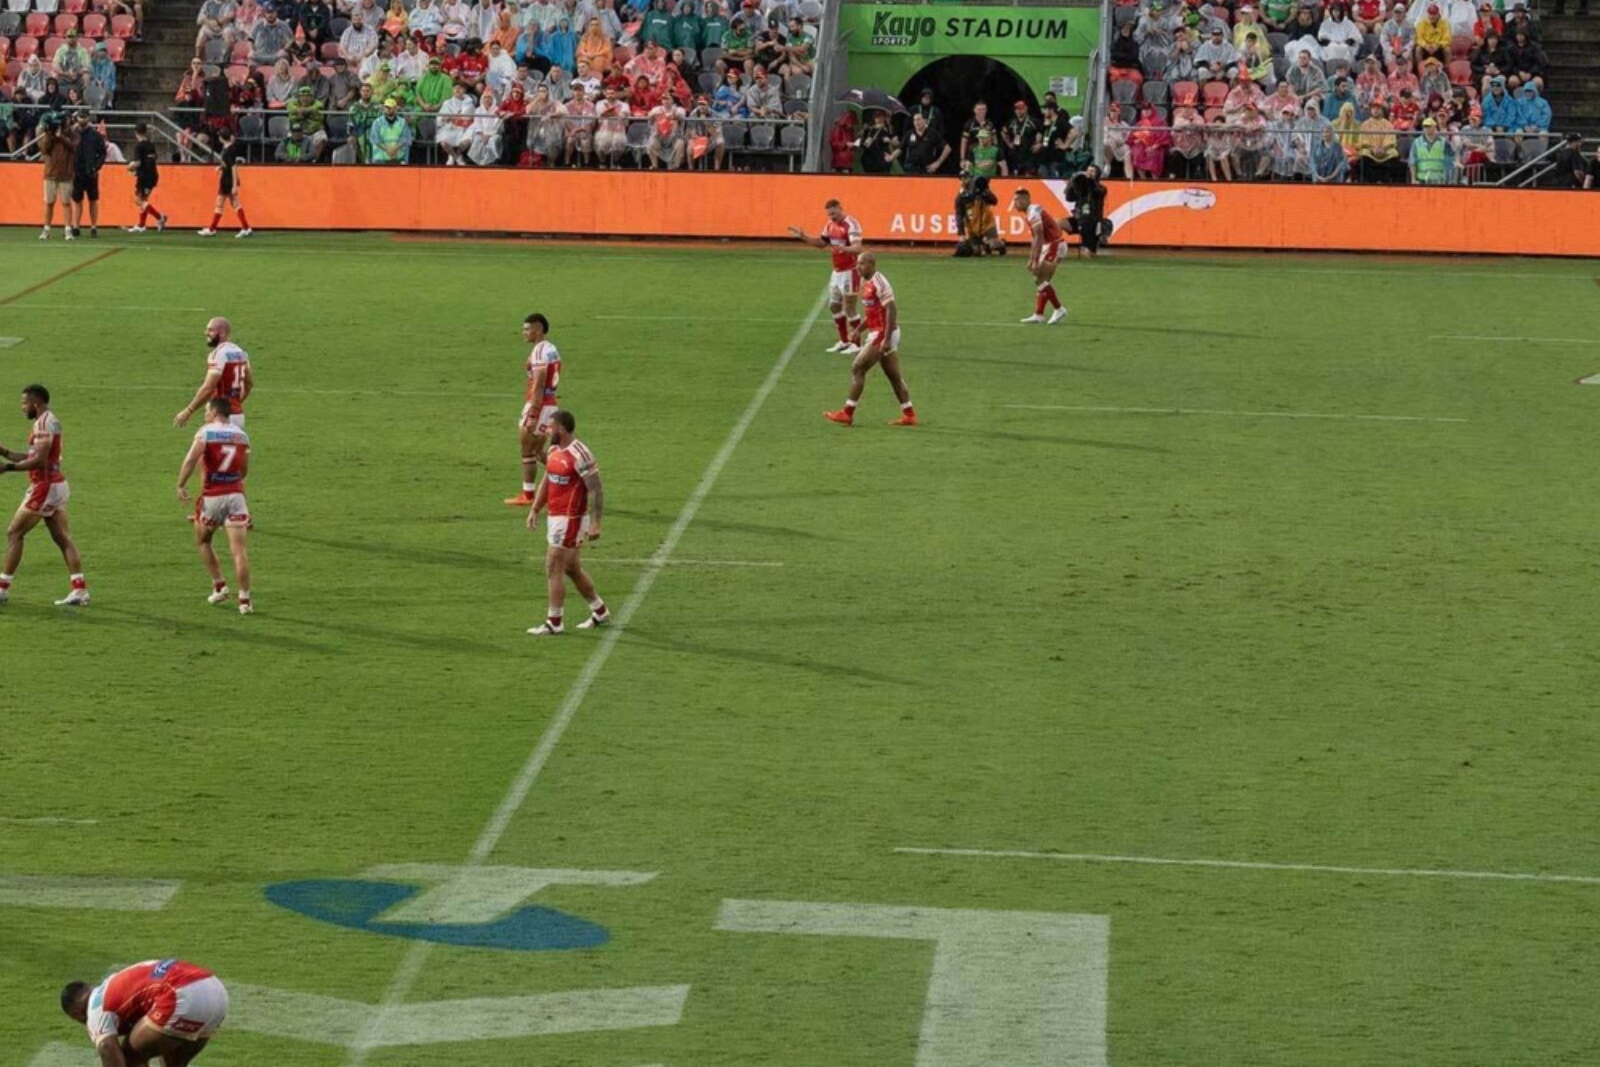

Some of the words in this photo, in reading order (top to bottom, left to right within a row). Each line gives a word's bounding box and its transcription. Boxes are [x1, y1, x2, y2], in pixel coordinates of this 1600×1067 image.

[872, 11, 937, 46] Kayo
[945, 17, 1069, 39] STADIUM
[872, 37, 910, 46] SPORTS
[890, 212, 1026, 236] AUSBLD
[220, 444, 238, 472] 7
